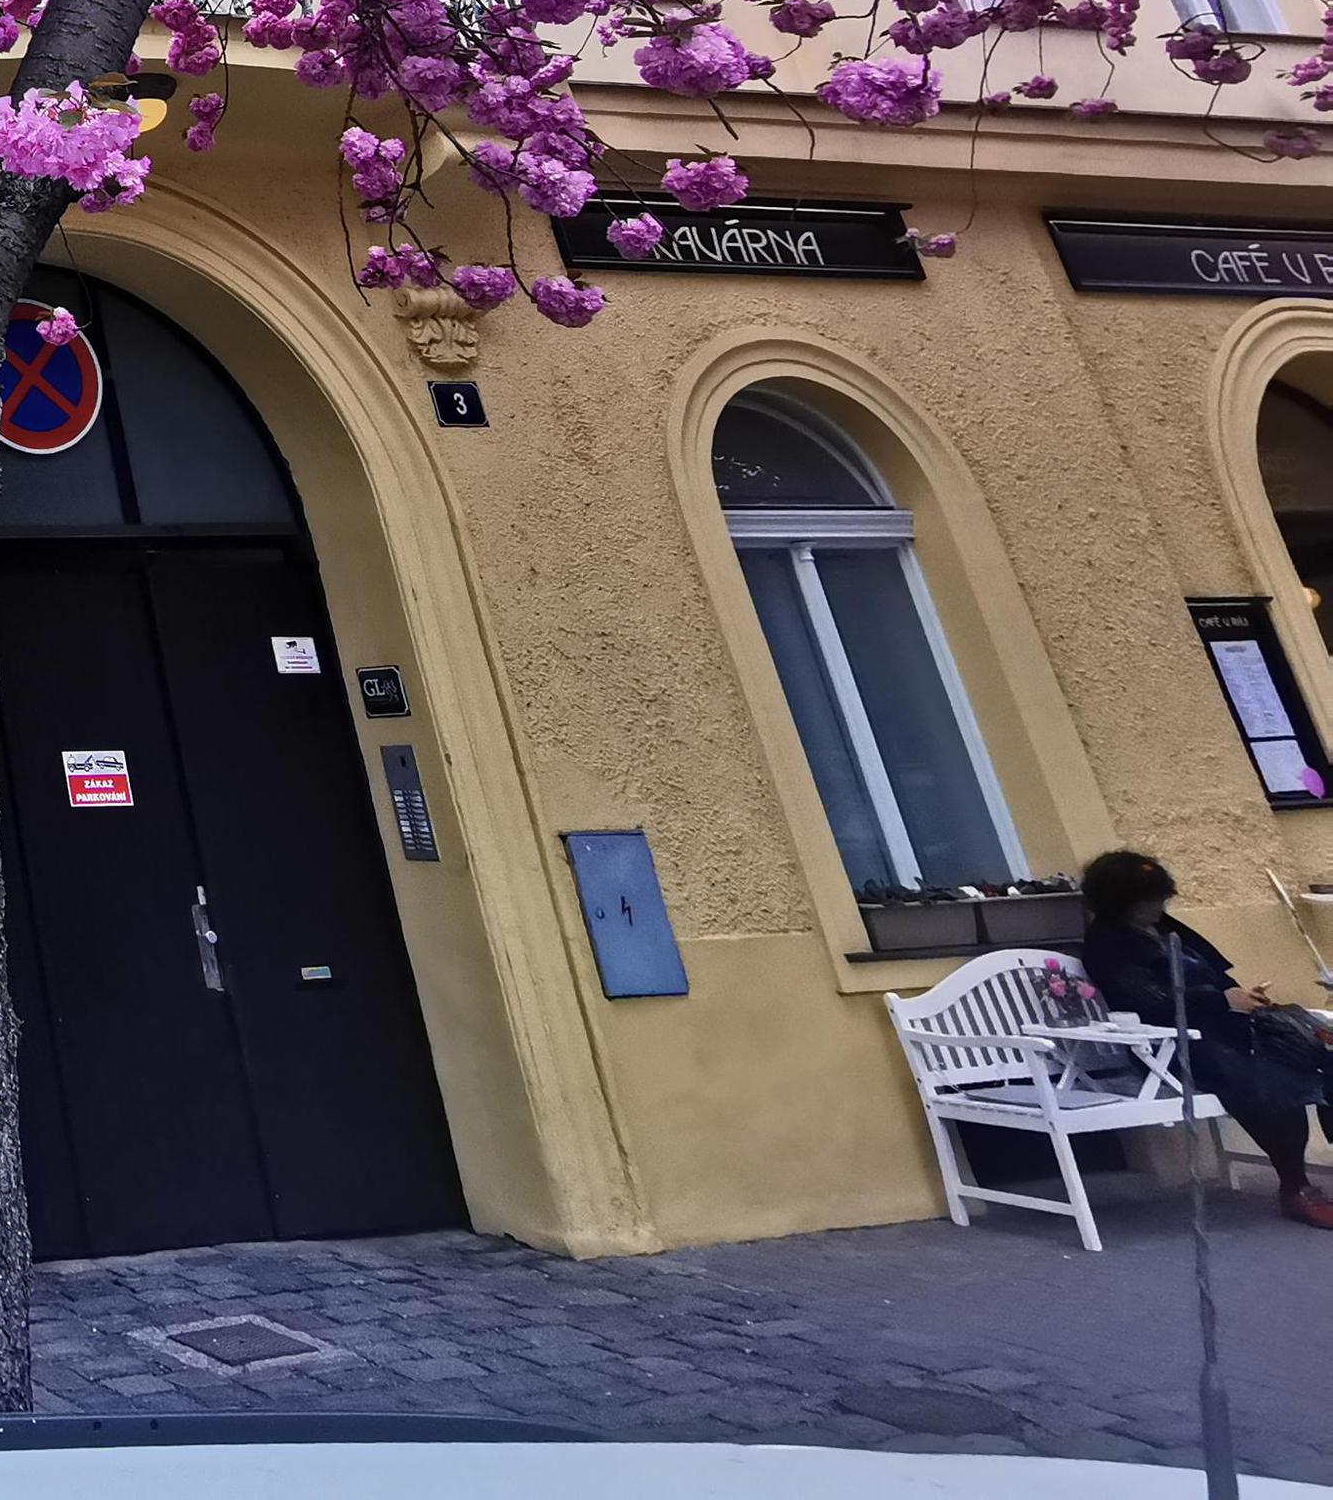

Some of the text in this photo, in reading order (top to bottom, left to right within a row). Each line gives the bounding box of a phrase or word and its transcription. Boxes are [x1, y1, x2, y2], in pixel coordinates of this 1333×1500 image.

[1191, 243, 1282, 284] CAFÉ
[453, 392, 467, 415] 3
[83, 779, 114, 789] ZÁKAZ
[76, 791, 127, 802] PARKOVÁNÍ
